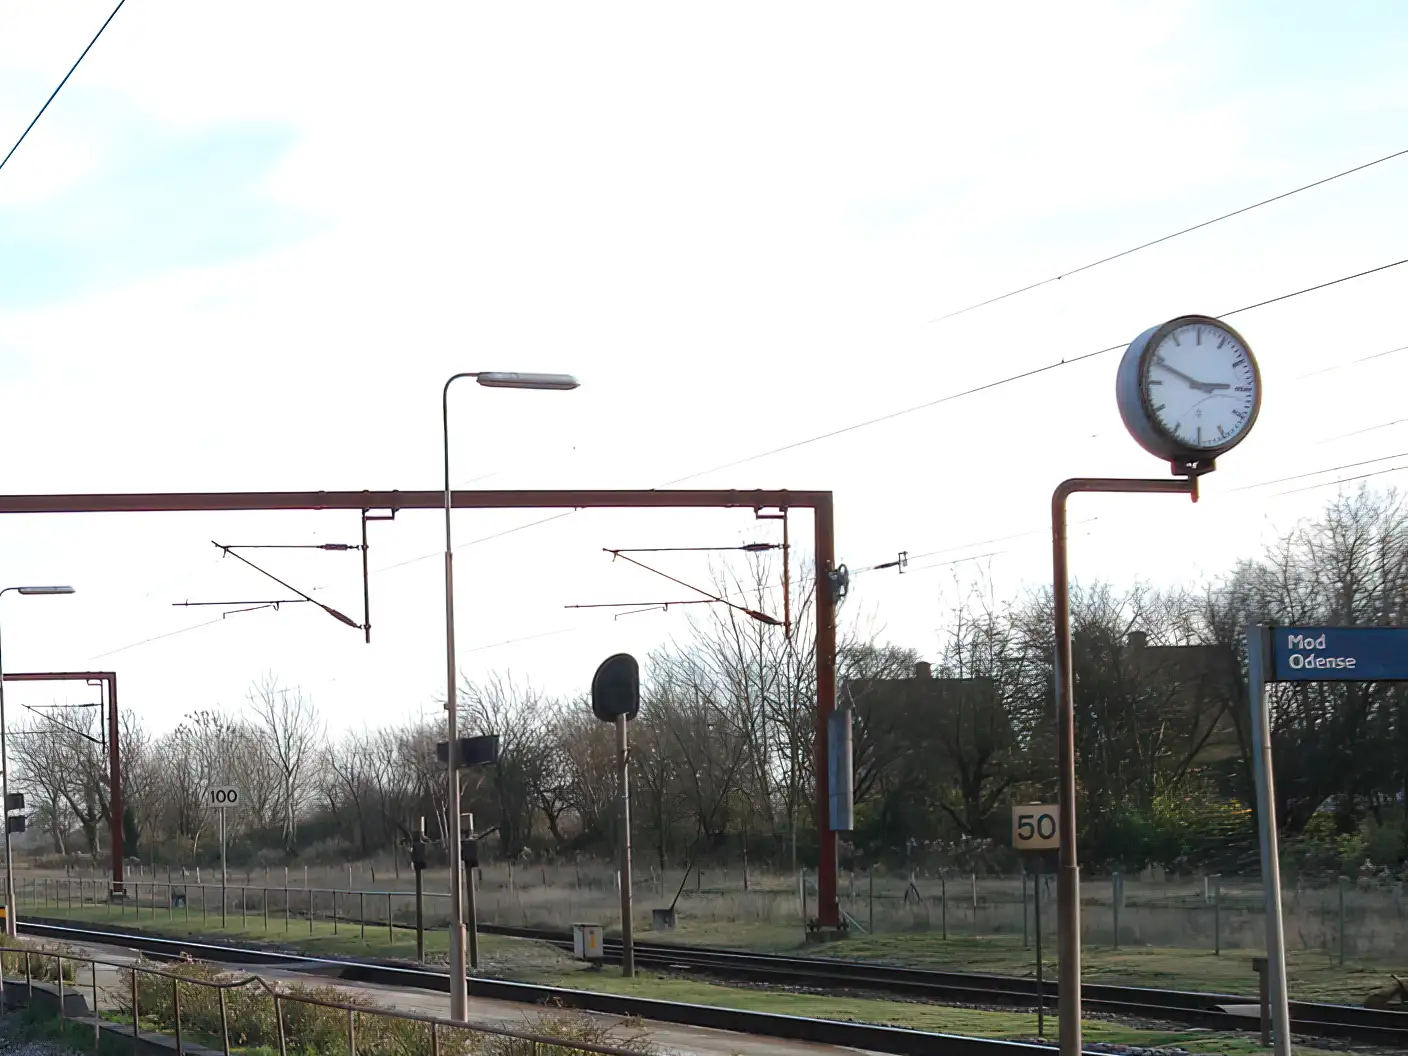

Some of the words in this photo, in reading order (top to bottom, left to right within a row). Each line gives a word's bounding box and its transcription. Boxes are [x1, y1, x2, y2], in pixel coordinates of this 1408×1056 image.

[1288, 633, 1326, 649] Mod
[1289, 653, 1357, 669] Odense
[211, 790, 237, 803] 100
[1018, 814, 1056, 840] 50
